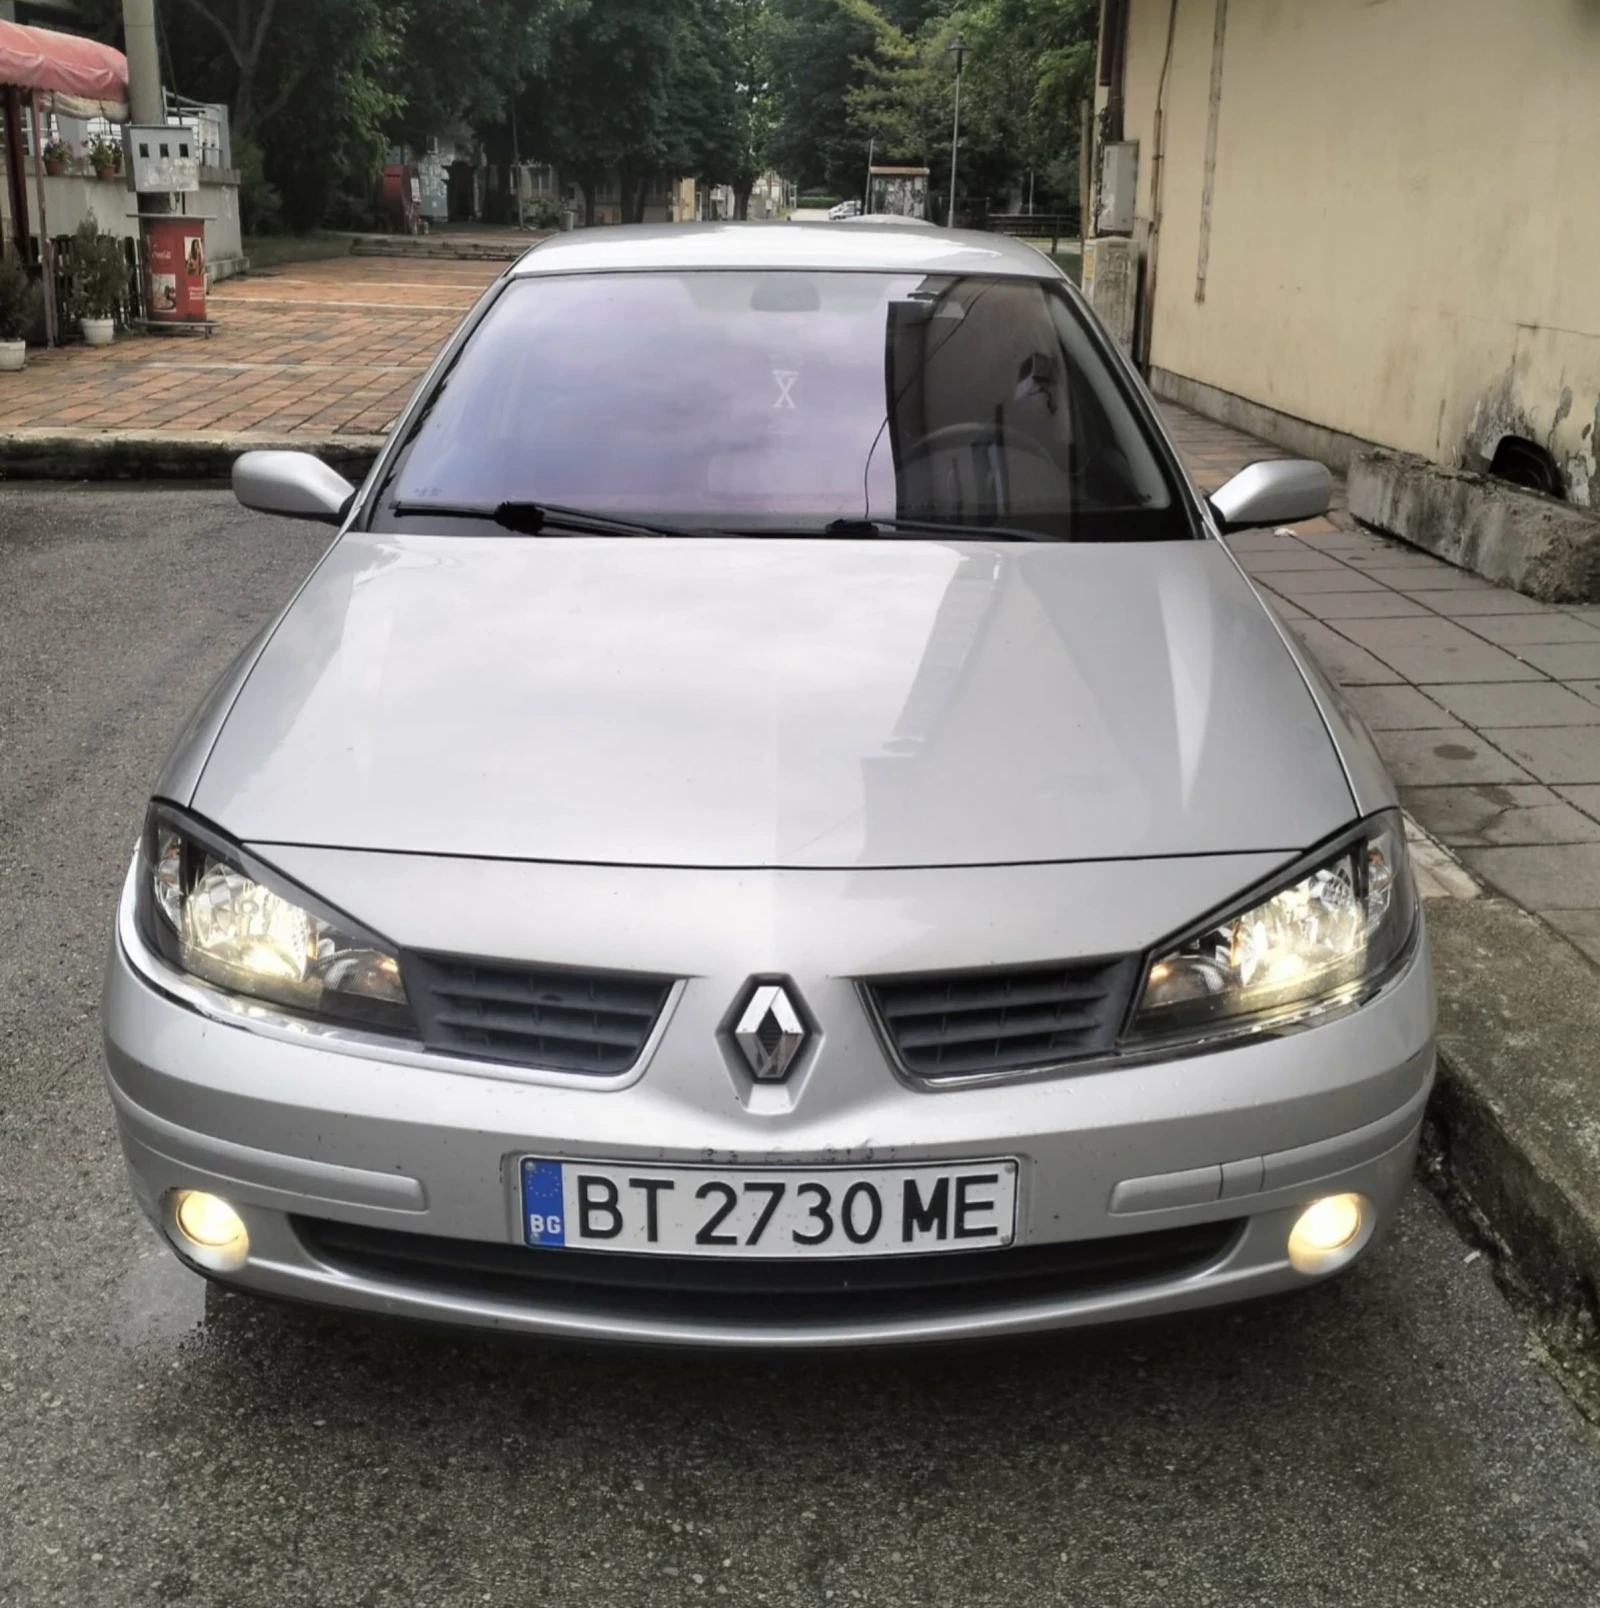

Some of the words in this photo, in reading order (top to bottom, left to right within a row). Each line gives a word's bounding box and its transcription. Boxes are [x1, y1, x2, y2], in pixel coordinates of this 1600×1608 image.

[530, 1213, 562, 1235] BG
[577, 1174, 675, 1243] BT
[695, 1181, 883, 1246] 2730
[902, 1173, 999, 1243] ME
